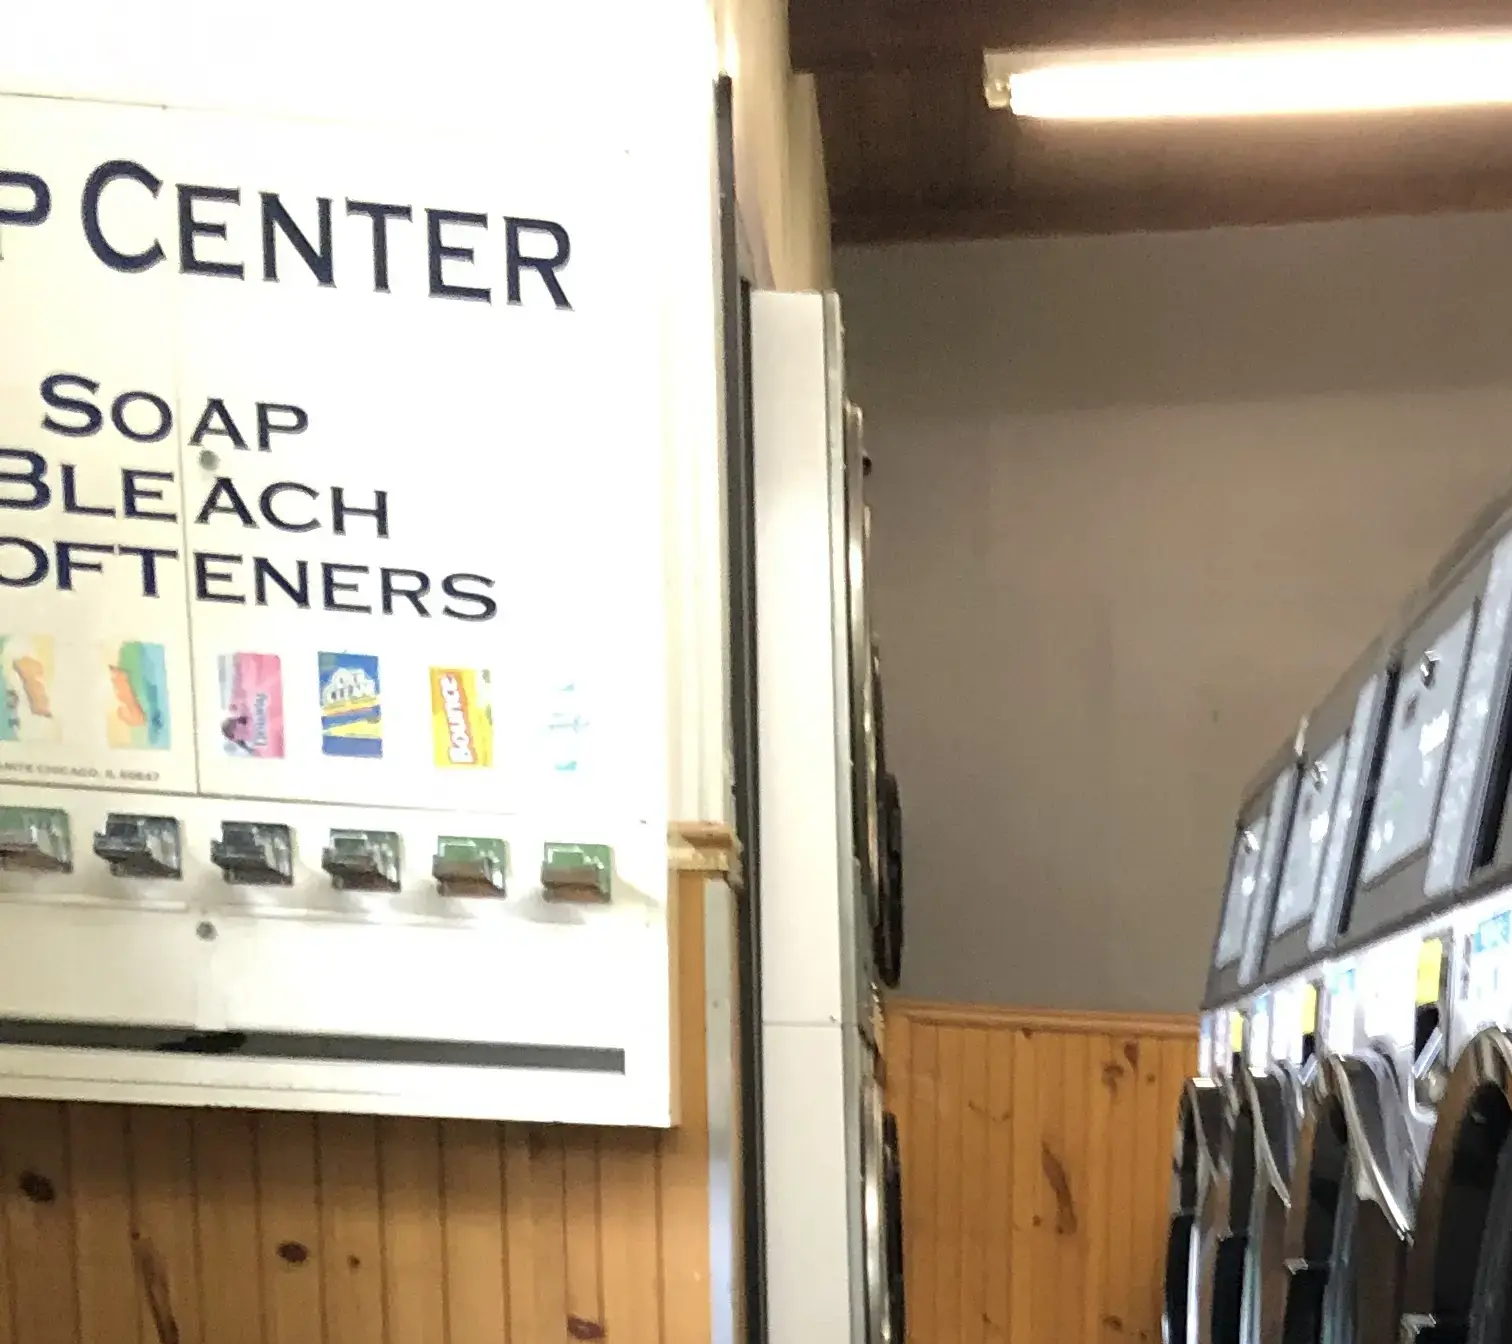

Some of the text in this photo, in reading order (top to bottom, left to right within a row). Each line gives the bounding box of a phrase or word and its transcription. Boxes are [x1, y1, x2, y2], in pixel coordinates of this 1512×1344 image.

[81, 159, 575, 311] CENTER
[40, 373, 309, 452] SOAP
[0, 448, 389, 538] BLEACH
[0, 536, 498, 622] OFTENERS
